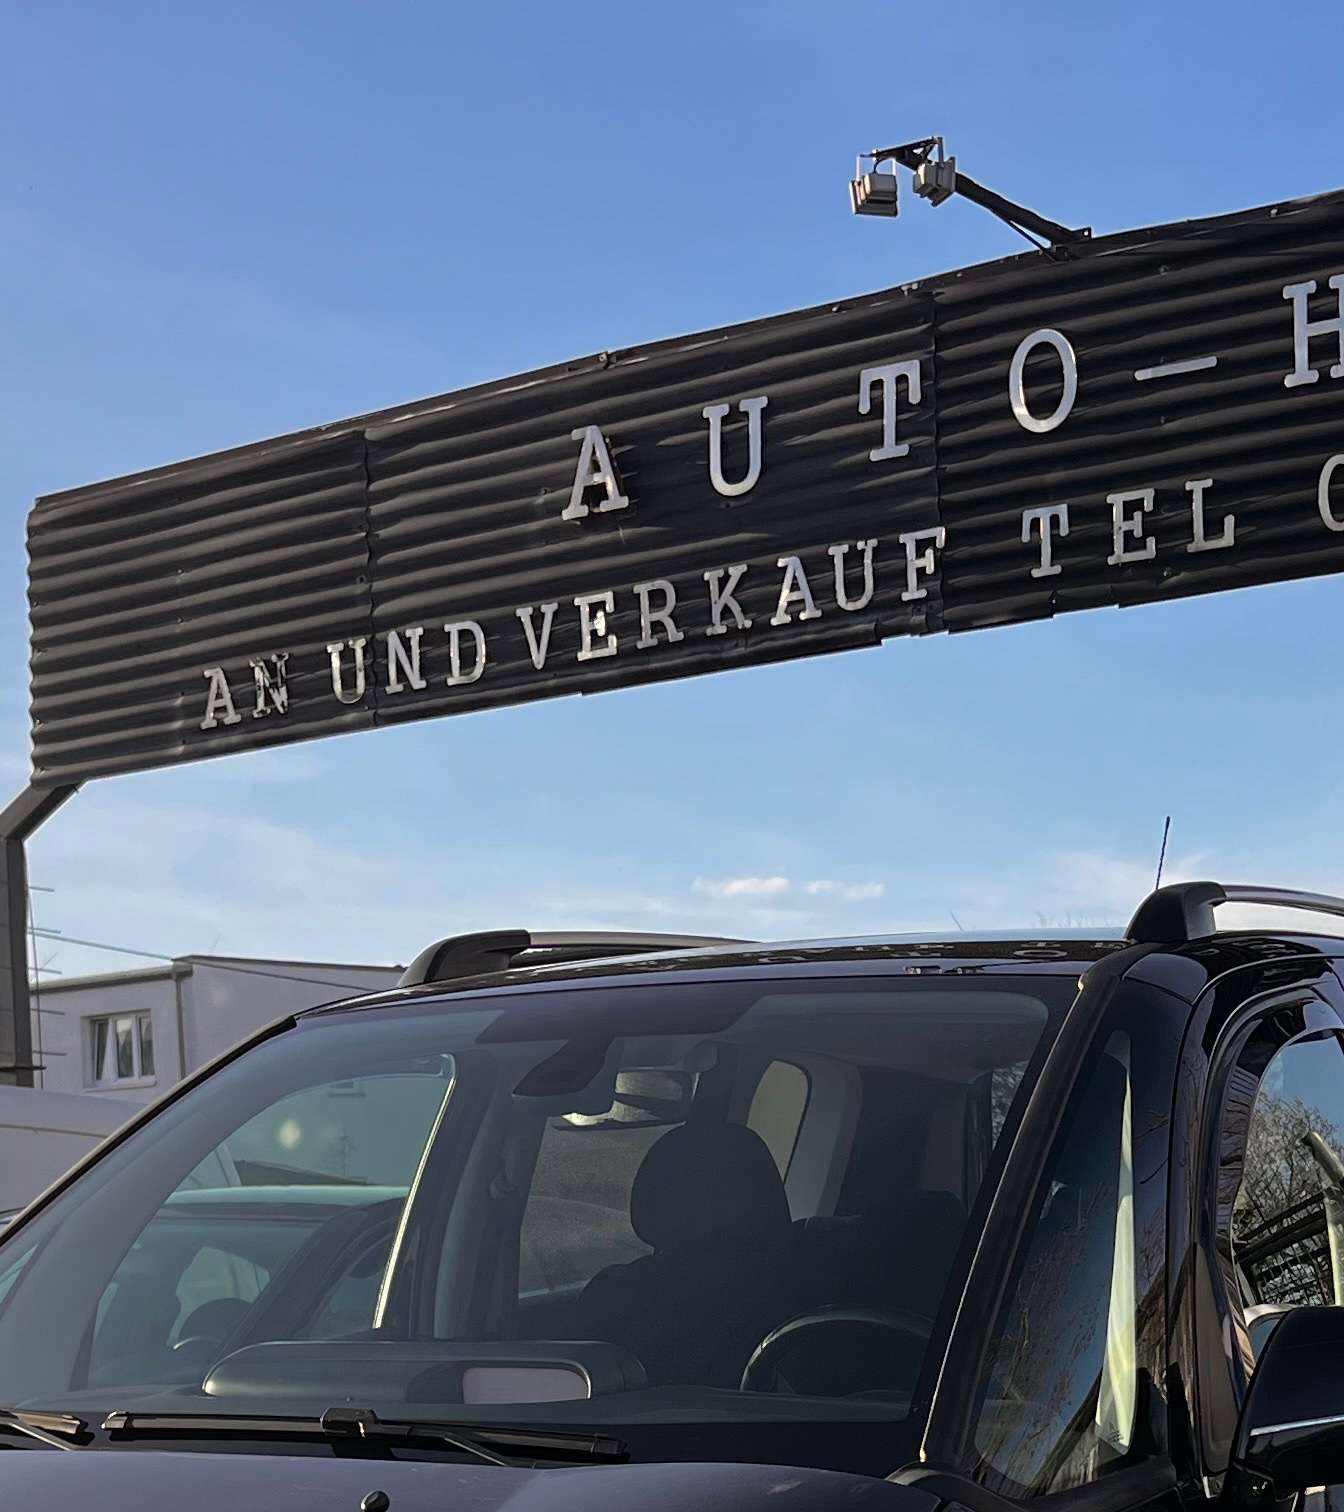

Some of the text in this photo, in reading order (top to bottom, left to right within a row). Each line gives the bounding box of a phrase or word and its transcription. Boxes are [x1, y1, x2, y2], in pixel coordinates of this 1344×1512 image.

[200, 651, 290, 729] AN
[326, 620, 487, 704] UND
[515, 526, 946, 670] VERKAUF
[1021, 477, 1235, 578] TEL
